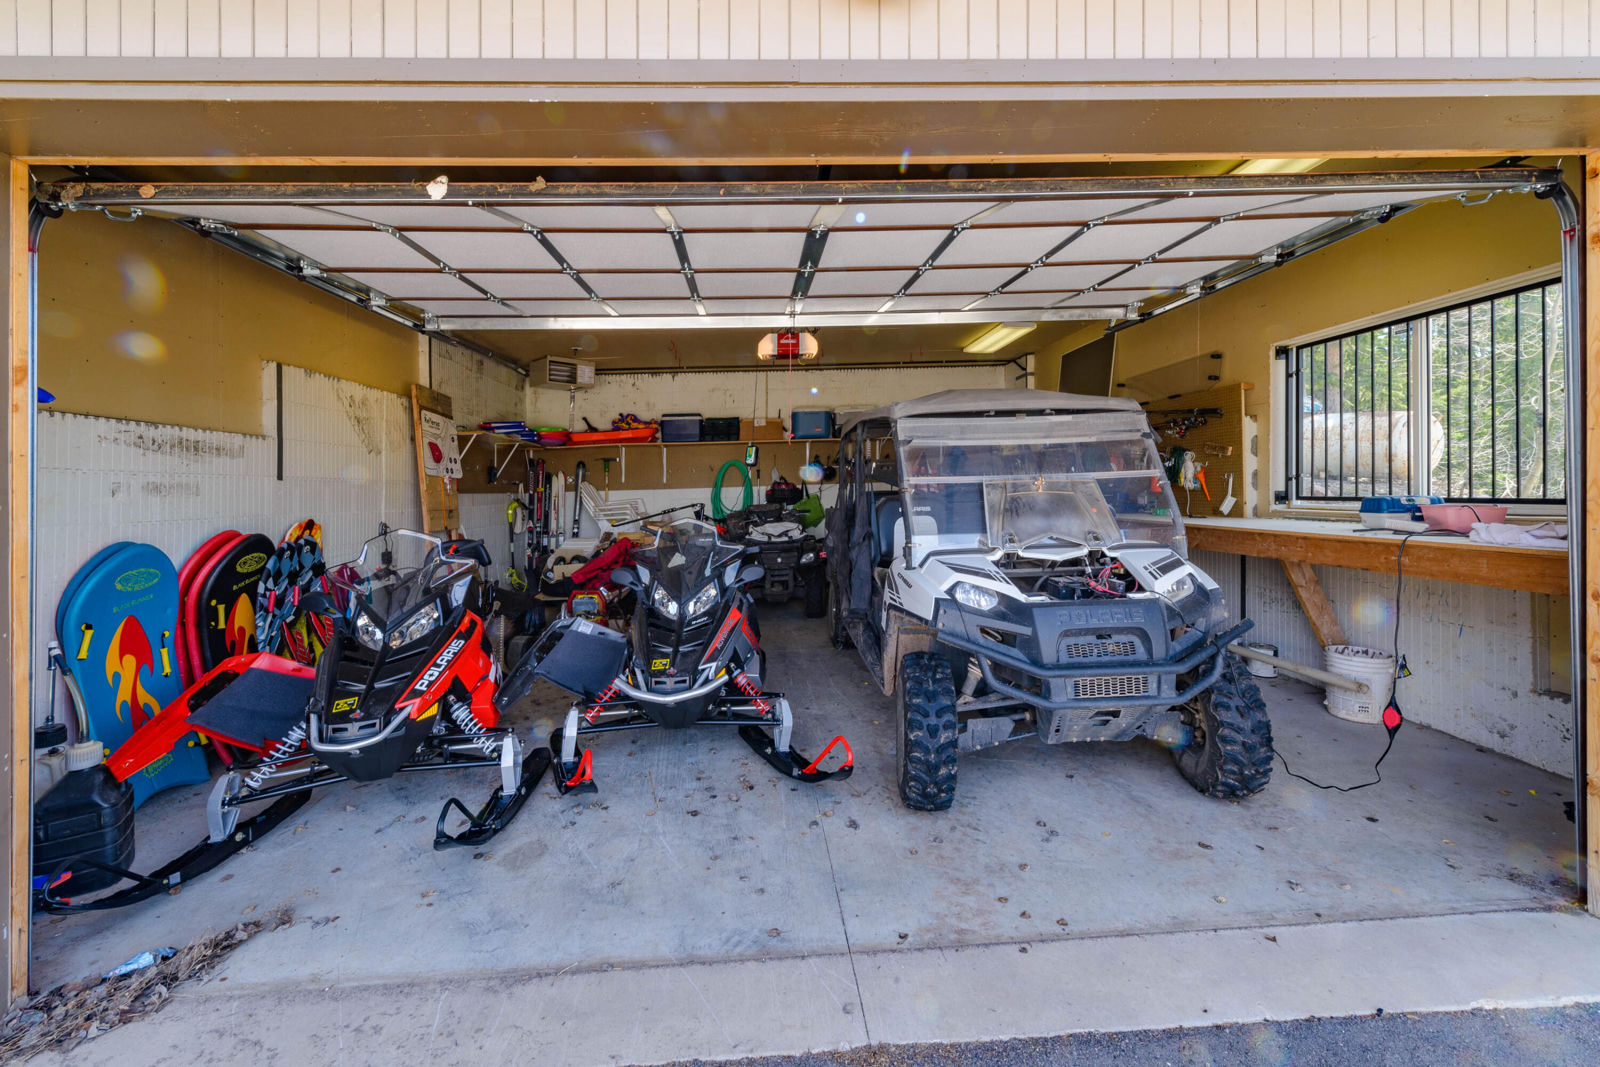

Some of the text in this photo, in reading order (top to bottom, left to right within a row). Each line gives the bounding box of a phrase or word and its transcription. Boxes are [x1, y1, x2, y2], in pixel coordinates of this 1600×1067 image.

[897, 572, 912, 589] CREW
[1056, 607, 1144, 625] POLARIS
[414, 638, 466, 691] POLARIS
